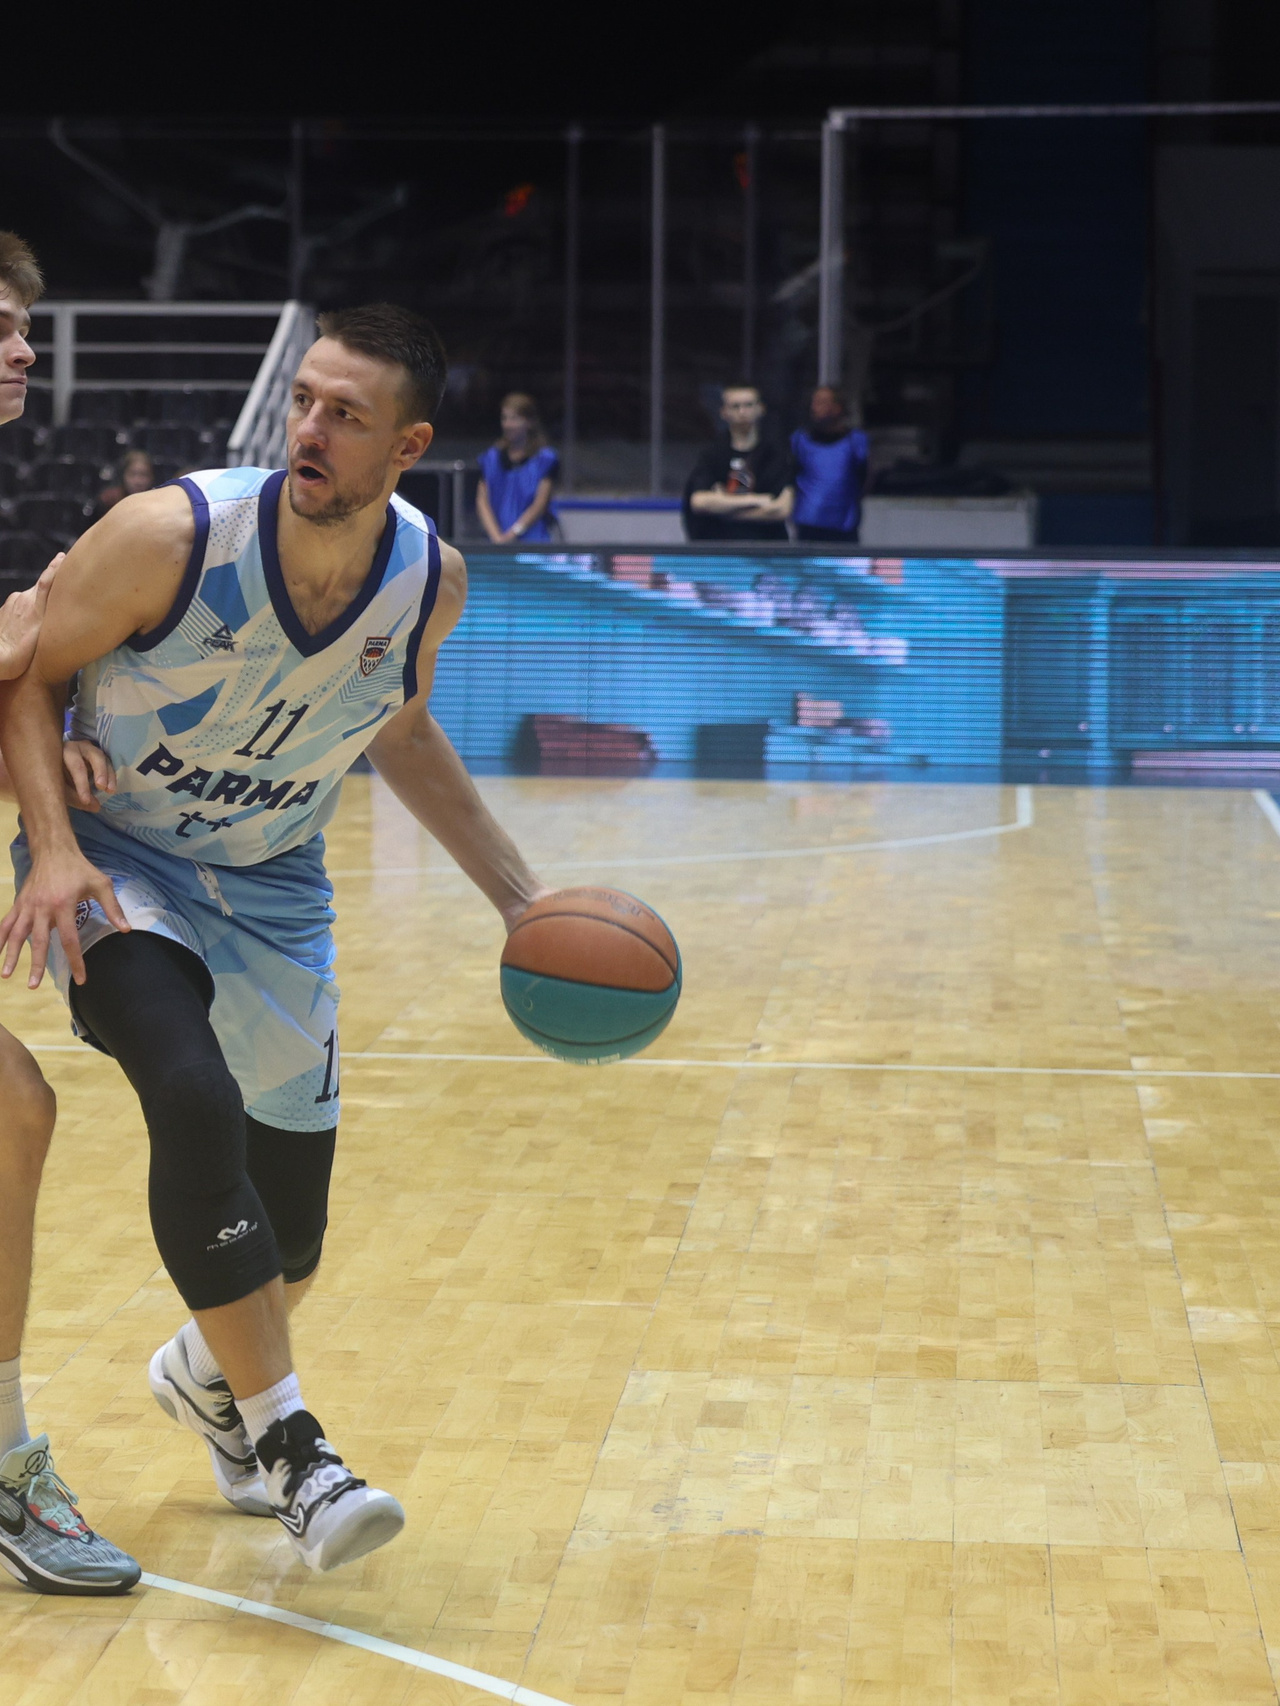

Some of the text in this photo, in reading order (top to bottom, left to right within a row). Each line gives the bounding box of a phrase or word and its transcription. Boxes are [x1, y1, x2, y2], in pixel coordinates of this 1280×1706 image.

[202, 637, 239, 653] PEAK
[233, 699, 311, 760] 11
[136, 742, 320, 809] PARMA
